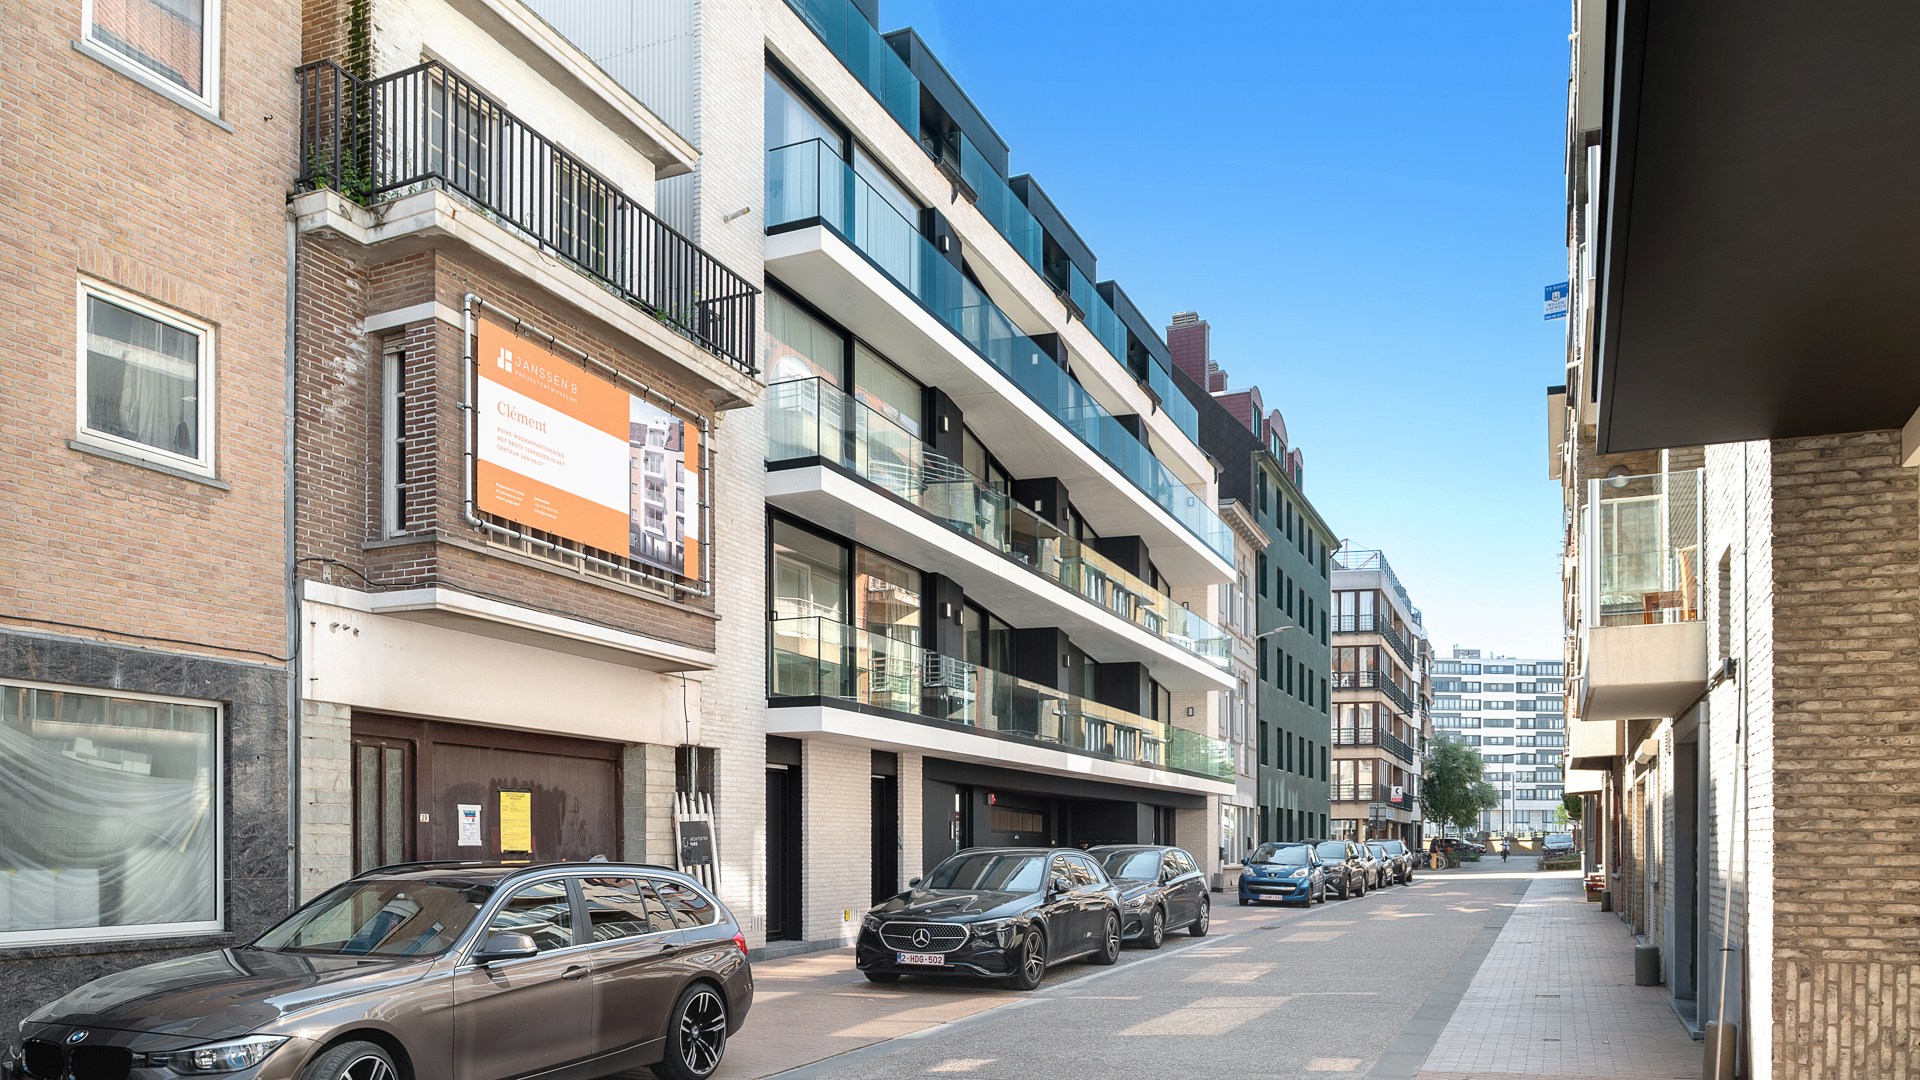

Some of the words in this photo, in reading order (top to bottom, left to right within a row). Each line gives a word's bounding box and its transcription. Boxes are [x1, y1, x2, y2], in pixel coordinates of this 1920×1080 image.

[514, 355, 569, 390] JANSSEN
[571, 383, 578, 395] B
[497, 401, 548, 434] Clément
[901, 954, 943, 965] 2-HDG-502
